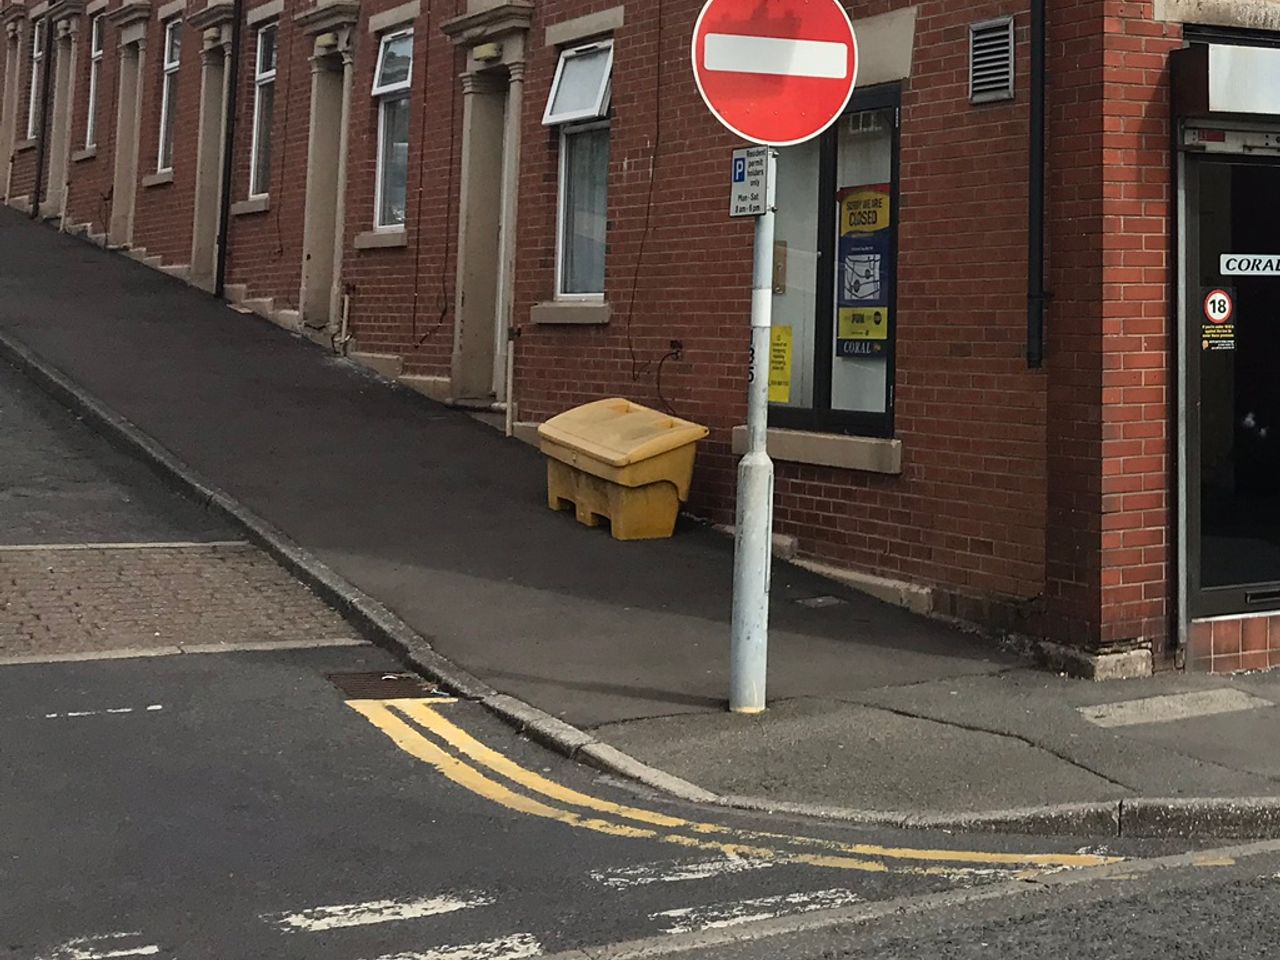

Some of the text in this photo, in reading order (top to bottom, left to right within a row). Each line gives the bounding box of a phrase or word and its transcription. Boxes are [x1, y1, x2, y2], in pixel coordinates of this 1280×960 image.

[735, 160, 744, 180] P
[849, 210, 877, 226] CLOSED
[1209, 299, 1227, 313] 18
[844, 341, 871, 353] CORAL
